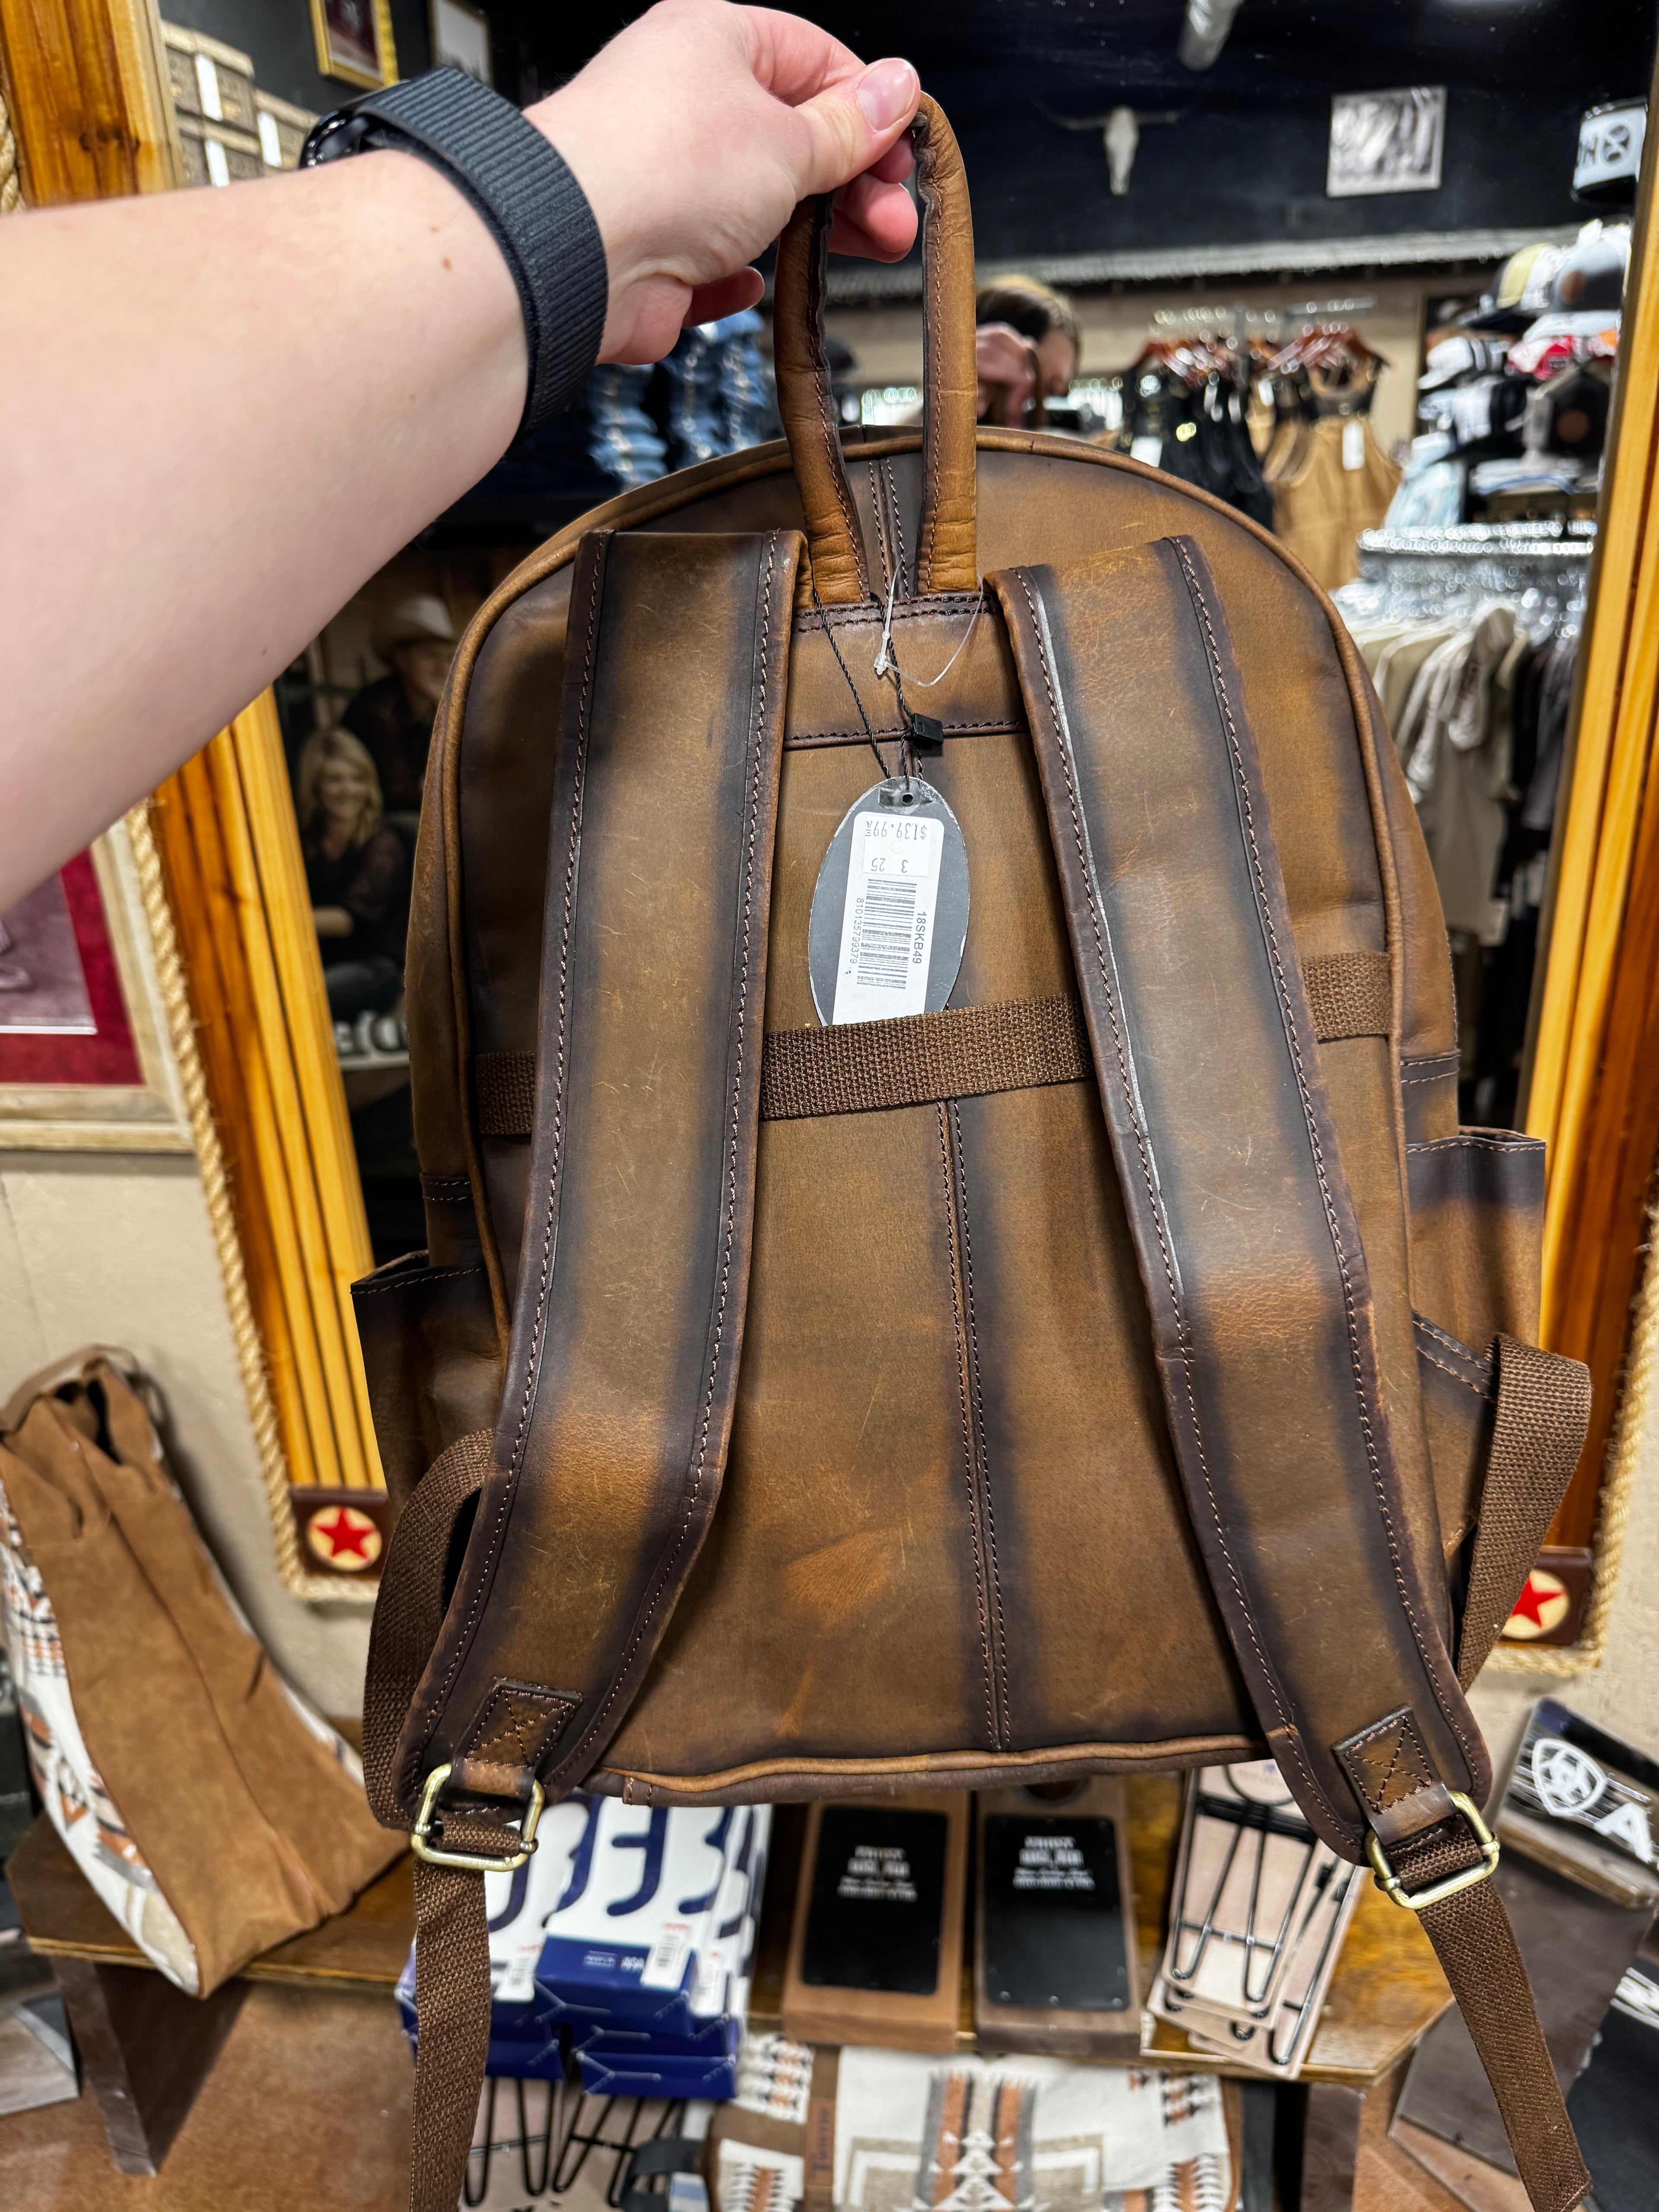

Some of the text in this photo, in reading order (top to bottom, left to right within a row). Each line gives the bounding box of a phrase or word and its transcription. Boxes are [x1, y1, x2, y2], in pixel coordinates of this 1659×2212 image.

[873, 820, 927, 841] $139.99
[871, 857, 909, 874] 3 25
[850, 897, 864, 964] 810135799379
[912, 911, 927, 964] 18SKB49
